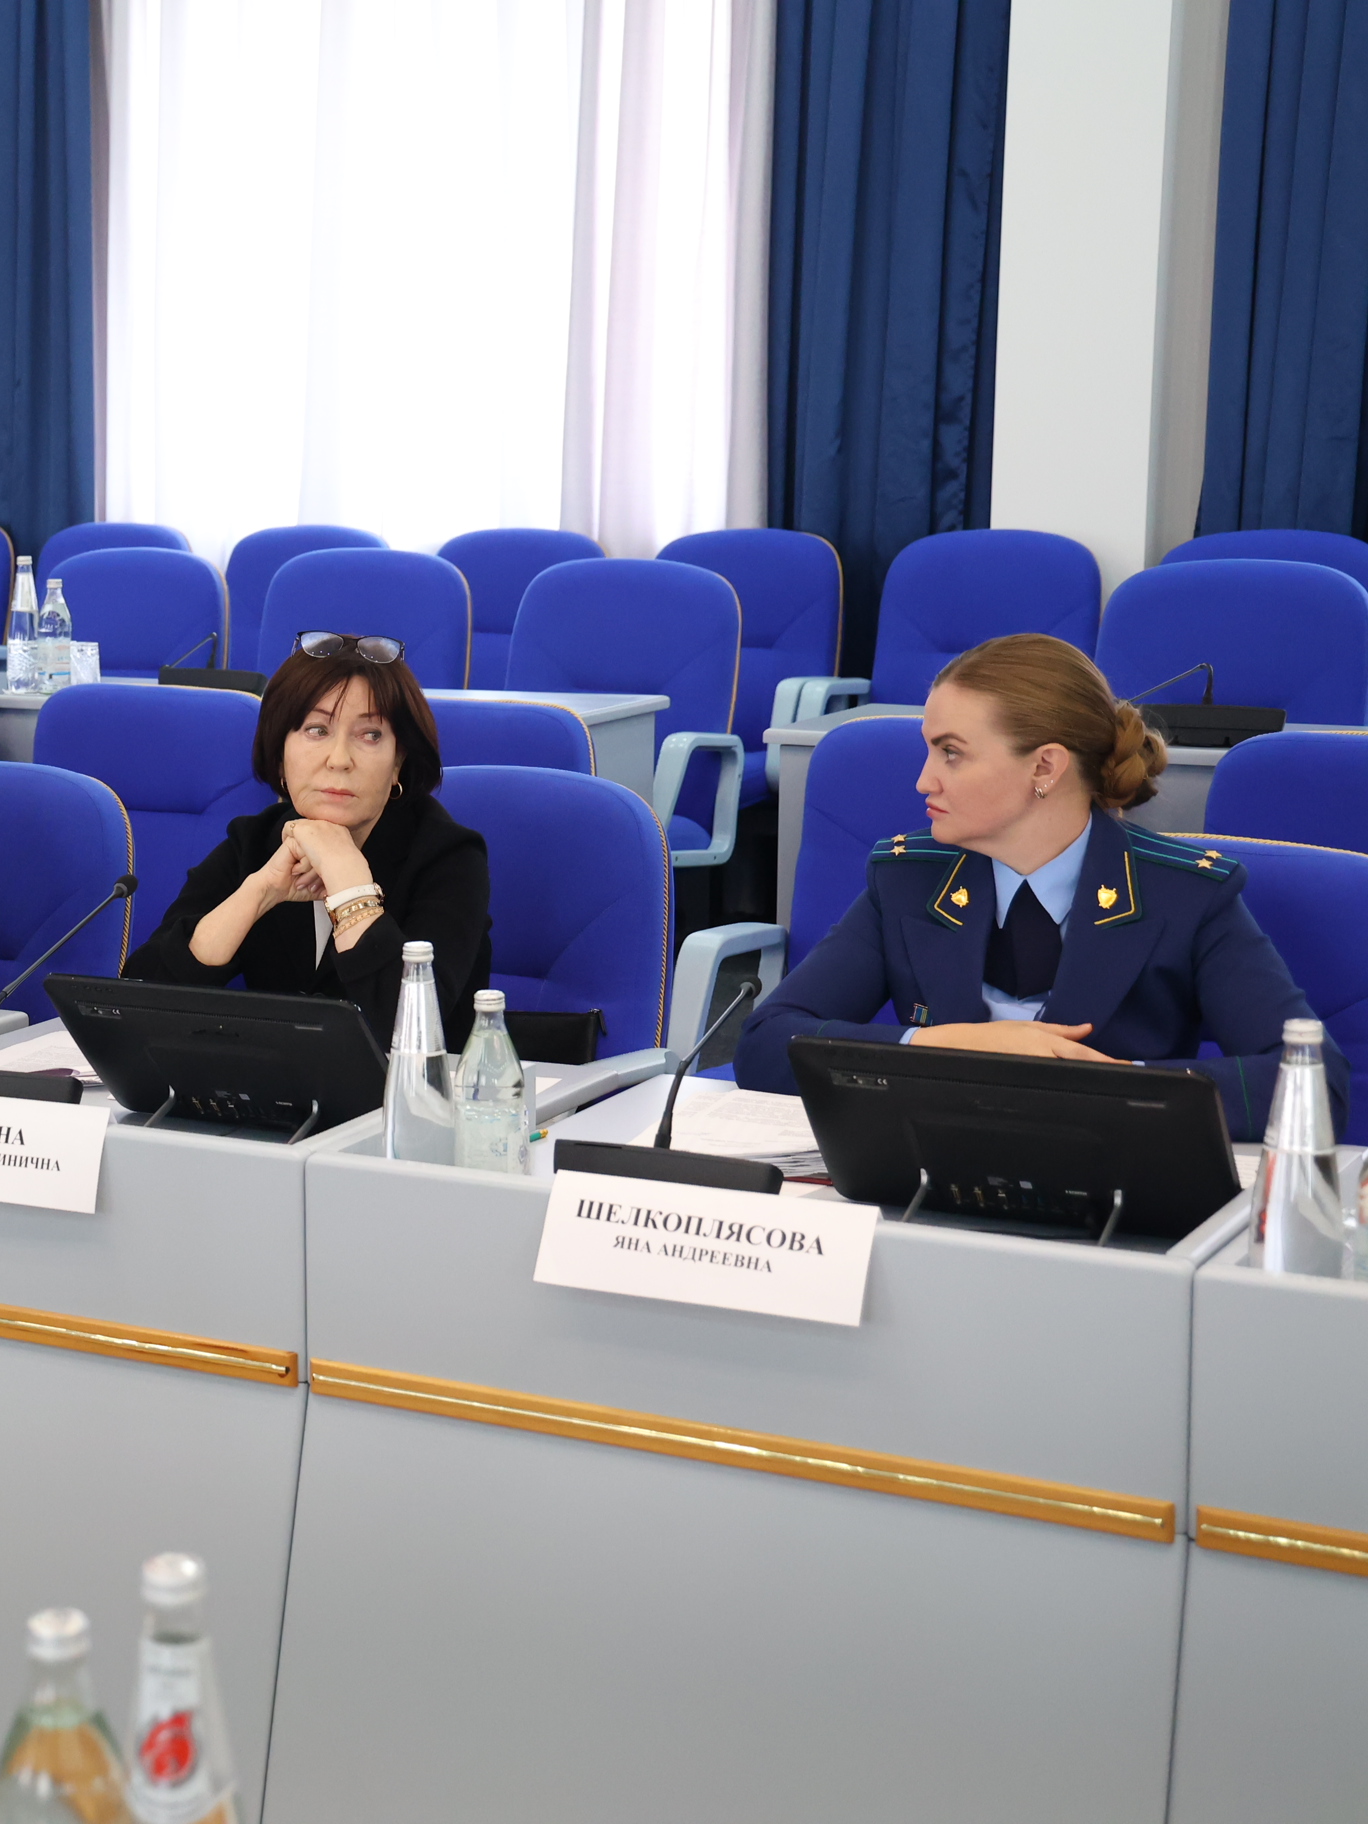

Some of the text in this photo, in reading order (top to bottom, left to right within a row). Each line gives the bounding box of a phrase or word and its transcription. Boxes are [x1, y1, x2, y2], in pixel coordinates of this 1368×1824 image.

[575, 1198, 824, 1256] ШЕЛКОПЛЯСОВА
[613, 1235, 773, 1273] ЯНА АНДРЕЕВНА
